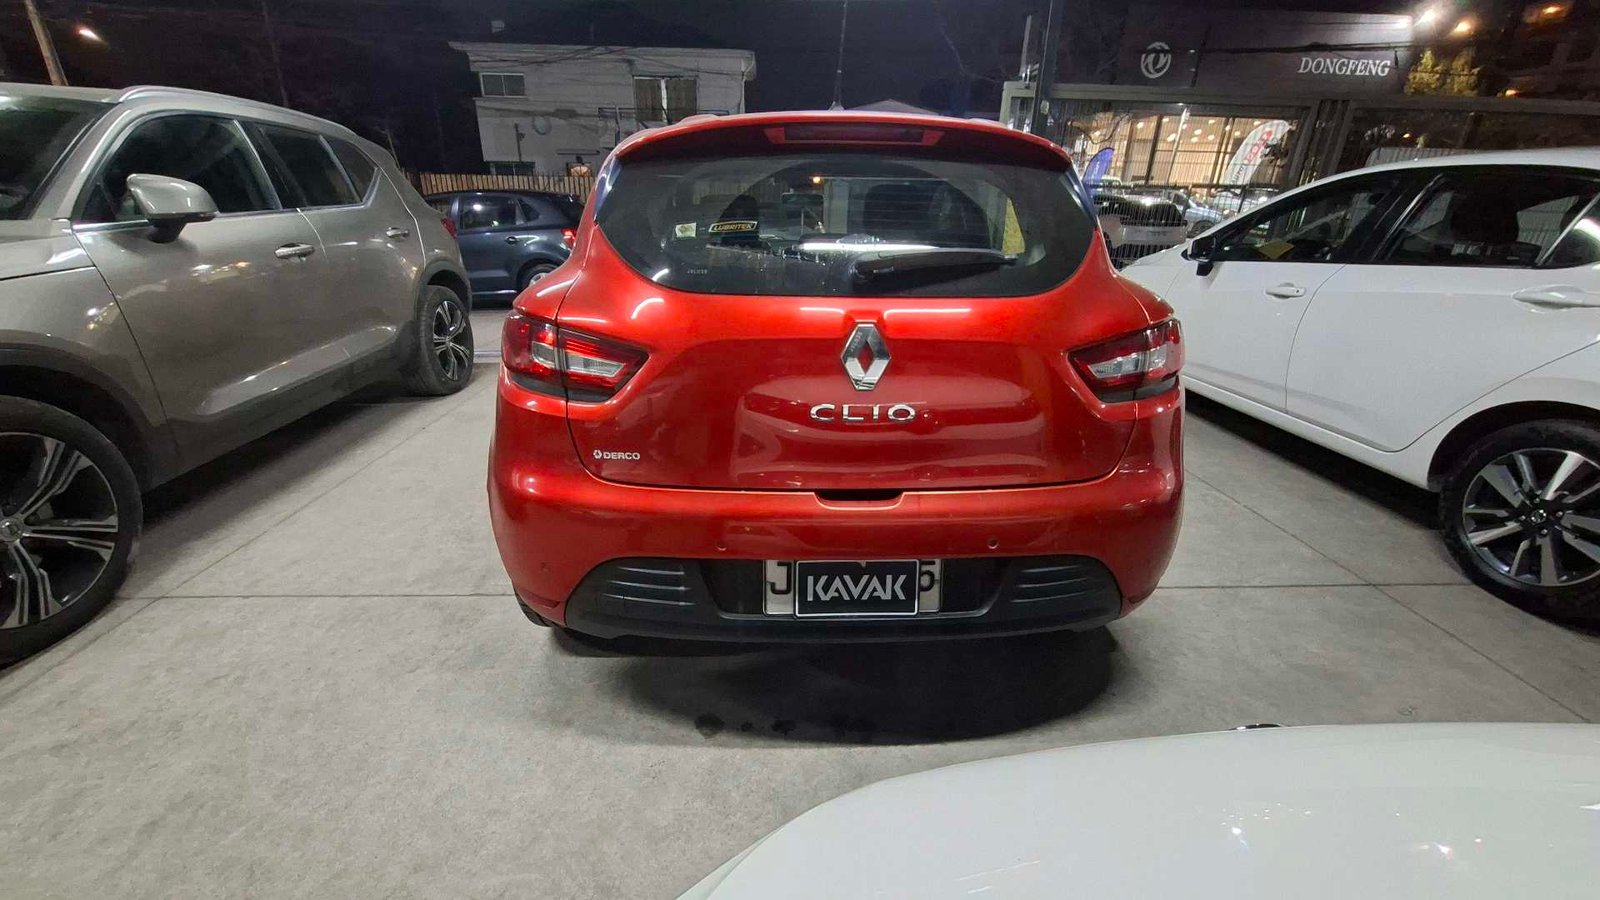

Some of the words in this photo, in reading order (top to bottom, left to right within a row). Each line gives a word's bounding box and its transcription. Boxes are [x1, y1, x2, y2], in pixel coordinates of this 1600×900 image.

[1298, 58, 1391, 76] DONGFENG
[810, 403, 916, 421] CLIO
[603, 451, 641, 460] DERCO
[807, 574, 907, 602] KAVAK
